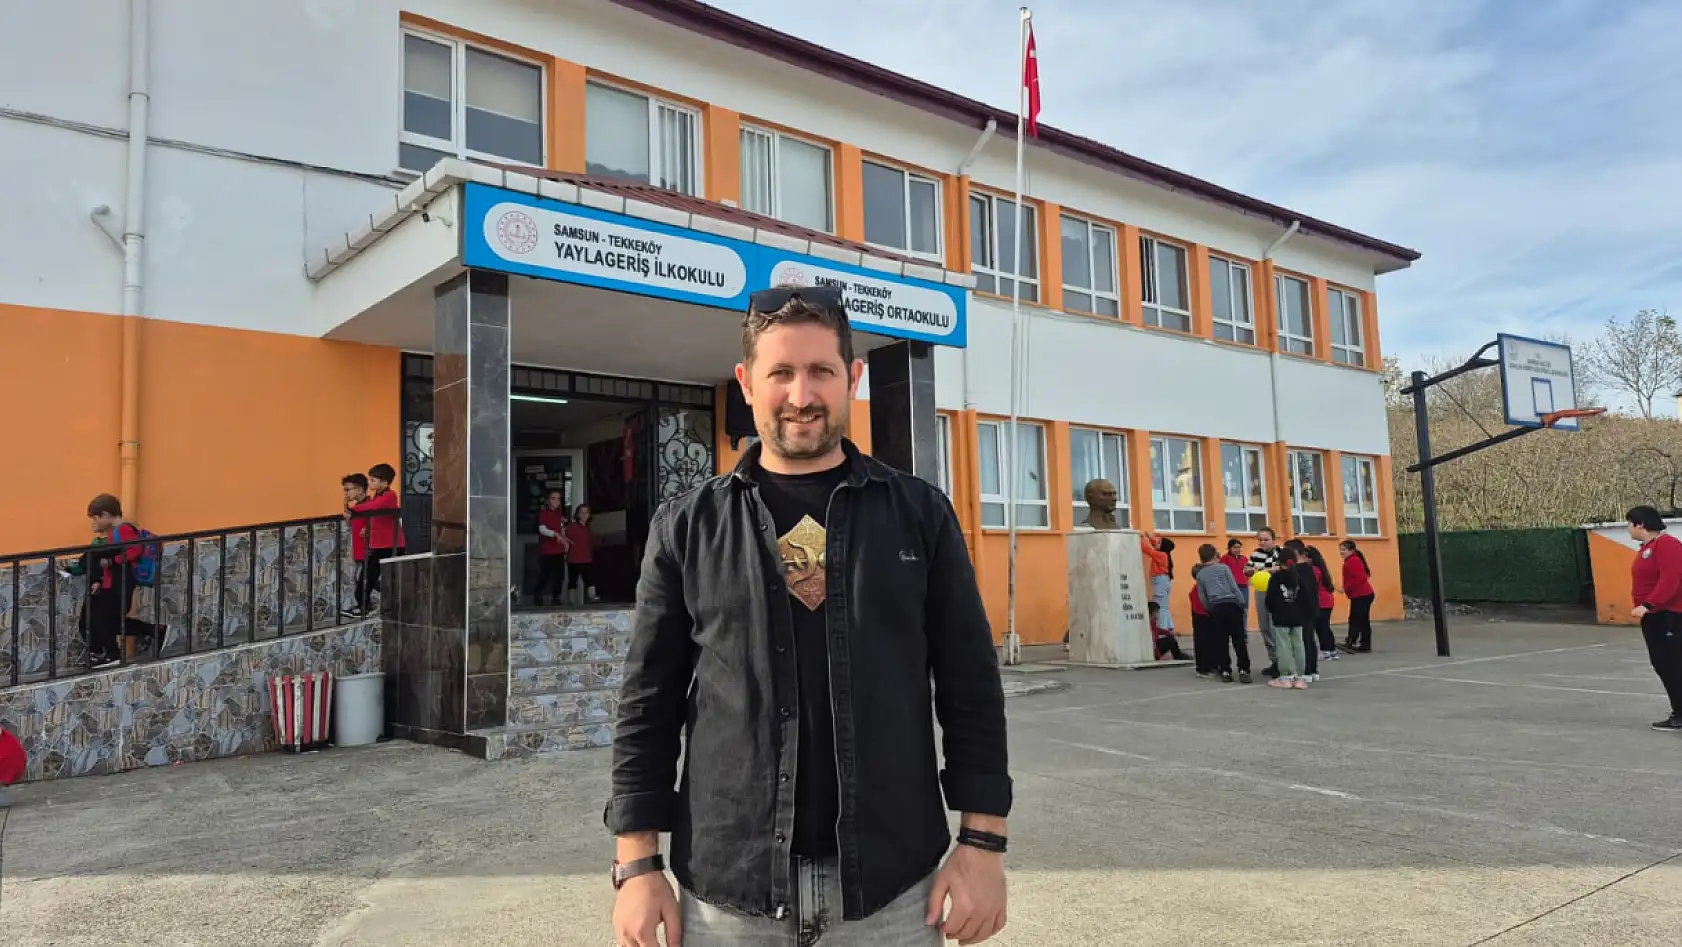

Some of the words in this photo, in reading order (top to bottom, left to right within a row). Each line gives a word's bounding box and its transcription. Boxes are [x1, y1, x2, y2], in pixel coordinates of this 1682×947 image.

[553, 223, 599, 244] SAMSUN
[608, 234, 663, 255] TEKKEKÖY
[554, 241, 649, 277] YAYLAGERİŞ
[654, 257, 724, 287] İLKOKULU
[814, 275, 848, 290] SAMSUN
[854, 282, 892, 299] TEKKEKÖY
[843, 297, 884, 319] AGERİŞ
[887, 305, 949, 327] ORTAOKULU
